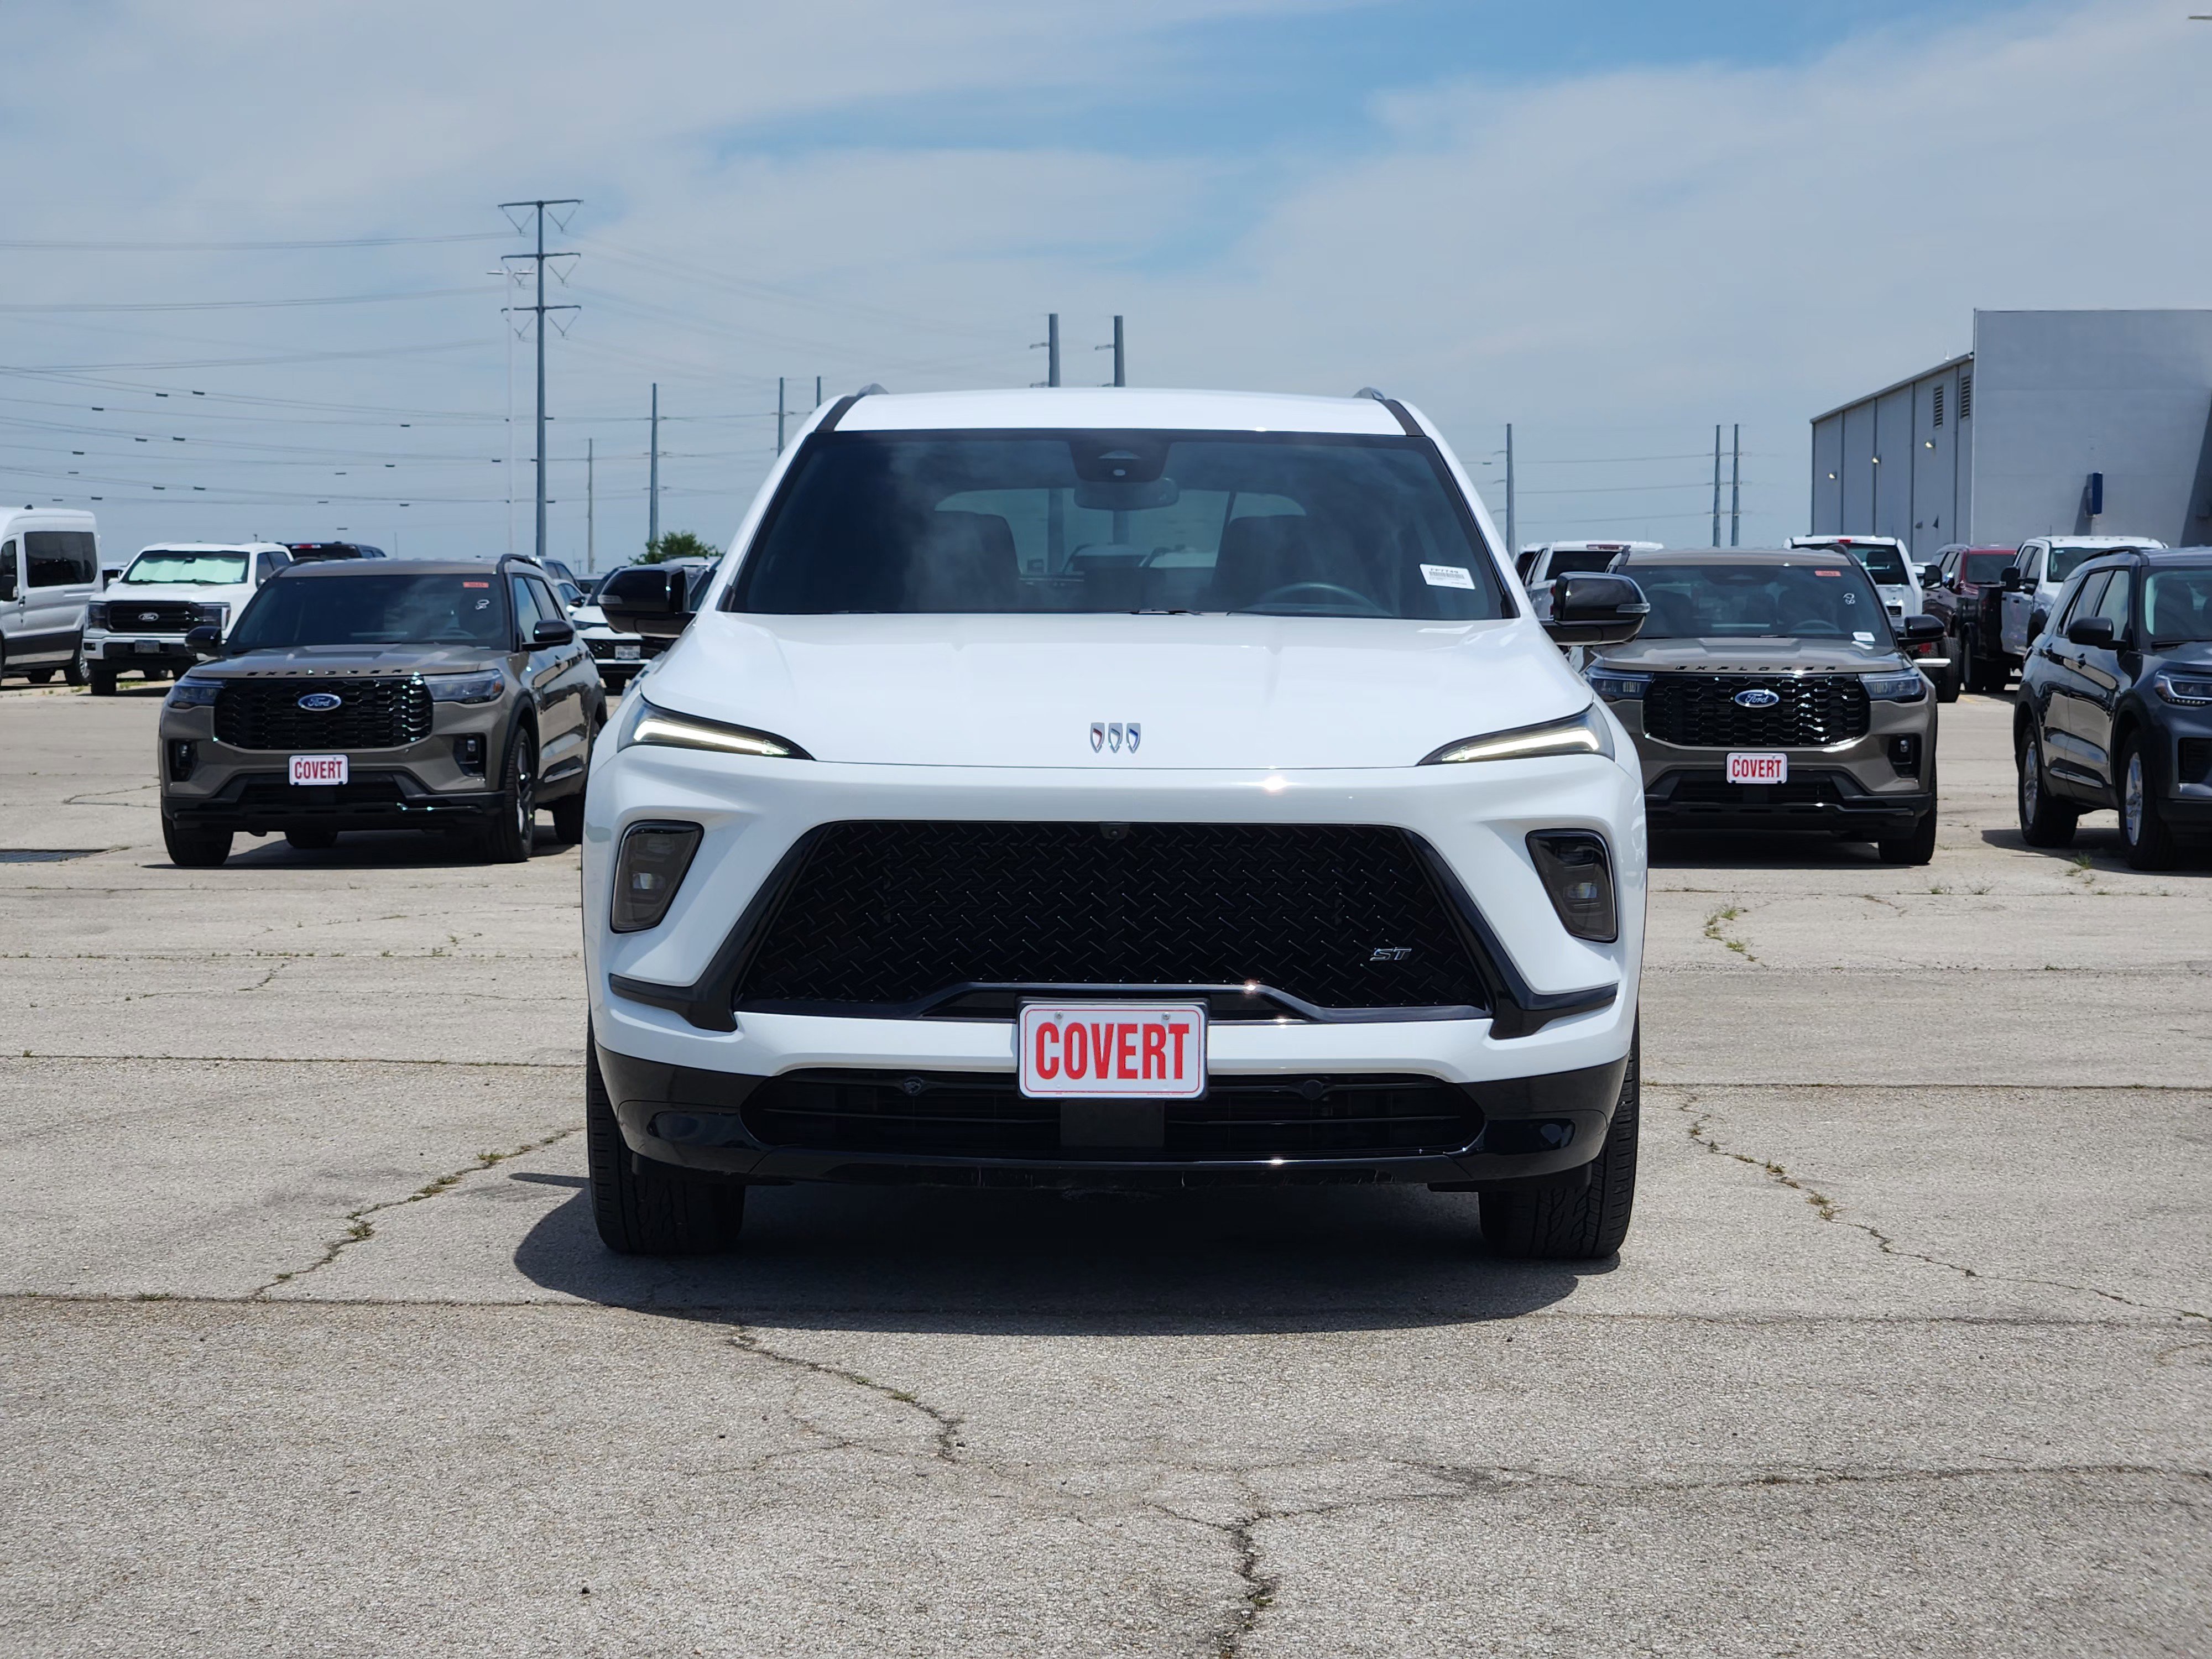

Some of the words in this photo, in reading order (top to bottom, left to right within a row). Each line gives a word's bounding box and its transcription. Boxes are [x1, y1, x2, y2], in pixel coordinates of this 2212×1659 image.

[295, 761, 342, 779] COVERT
[1732, 759, 1782, 778] COVERT
[1369, 947, 1412, 961] ST
[1036, 1022, 1190, 1079] COVERT
